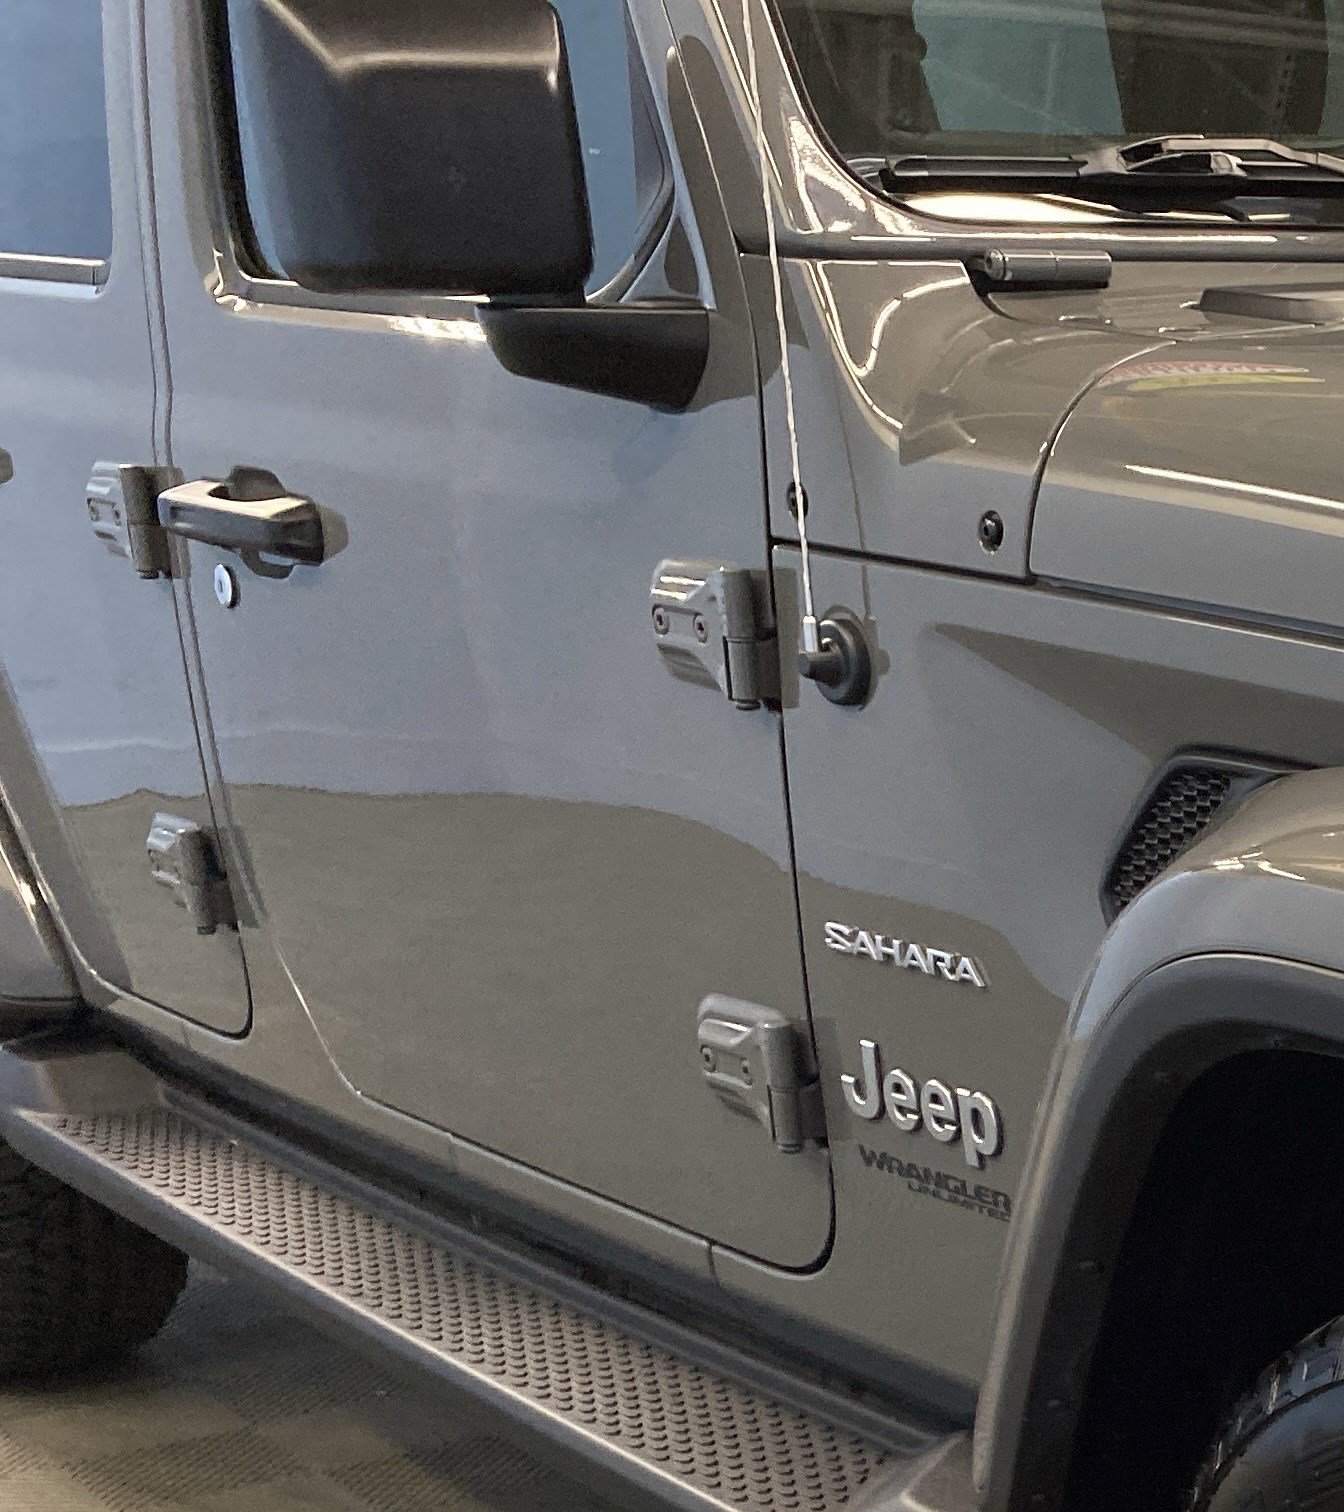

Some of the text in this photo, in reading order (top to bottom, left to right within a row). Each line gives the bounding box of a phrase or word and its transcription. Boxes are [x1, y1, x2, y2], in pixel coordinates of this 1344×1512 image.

[824, 921, 991, 989] SAHARA
[840, 1039, 1004, 1171] Jeep
[858, 1142, 1012, 1214] WRANGLER
